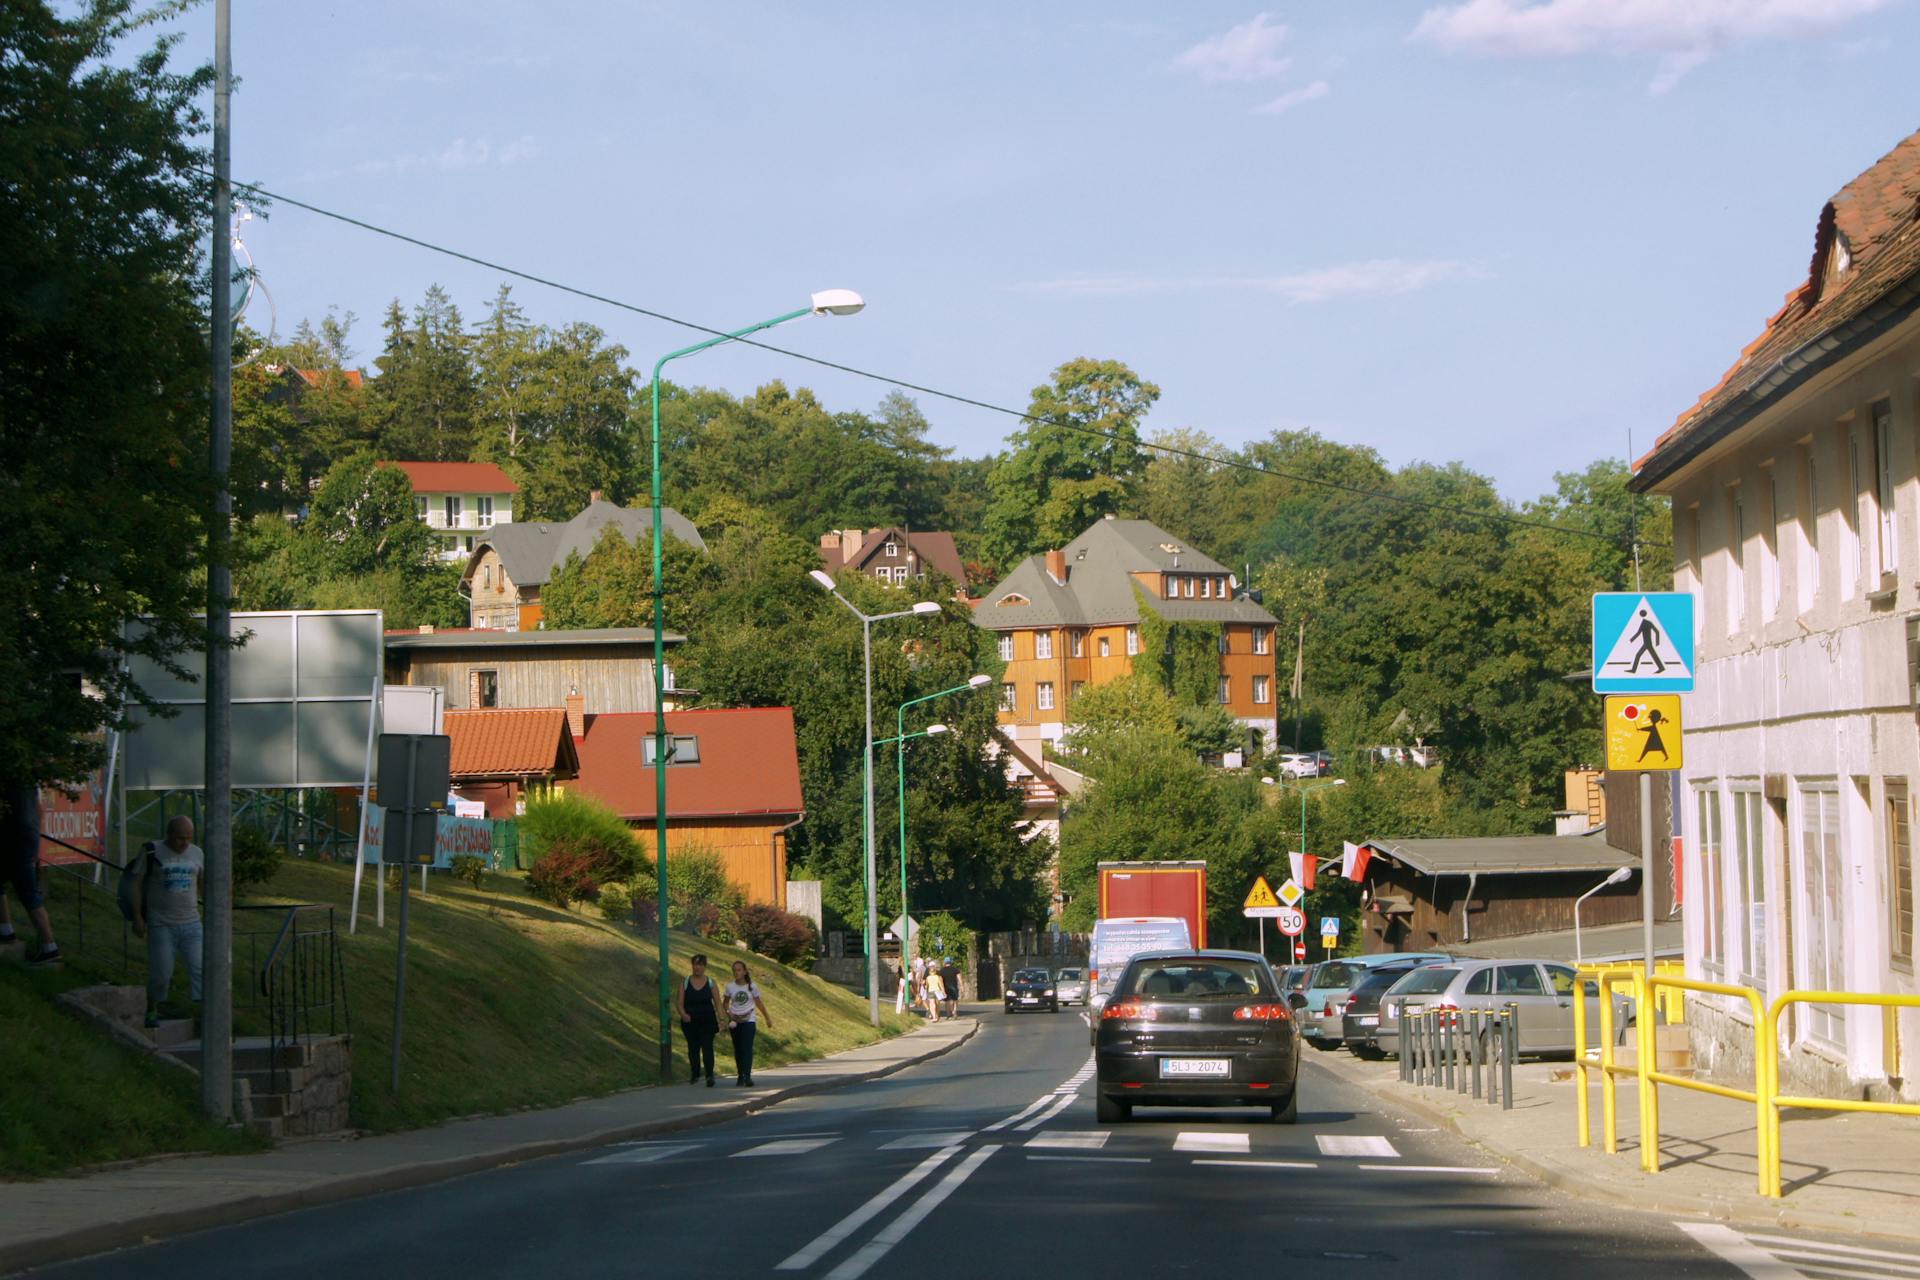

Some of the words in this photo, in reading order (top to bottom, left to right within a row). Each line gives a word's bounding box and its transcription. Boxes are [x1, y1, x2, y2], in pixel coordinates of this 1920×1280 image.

[1283, 915, 1301, 928] 50
[1171, 1062, 1190, 1072] 5L3
[1198, 1062, 1223, 1072] 2074
